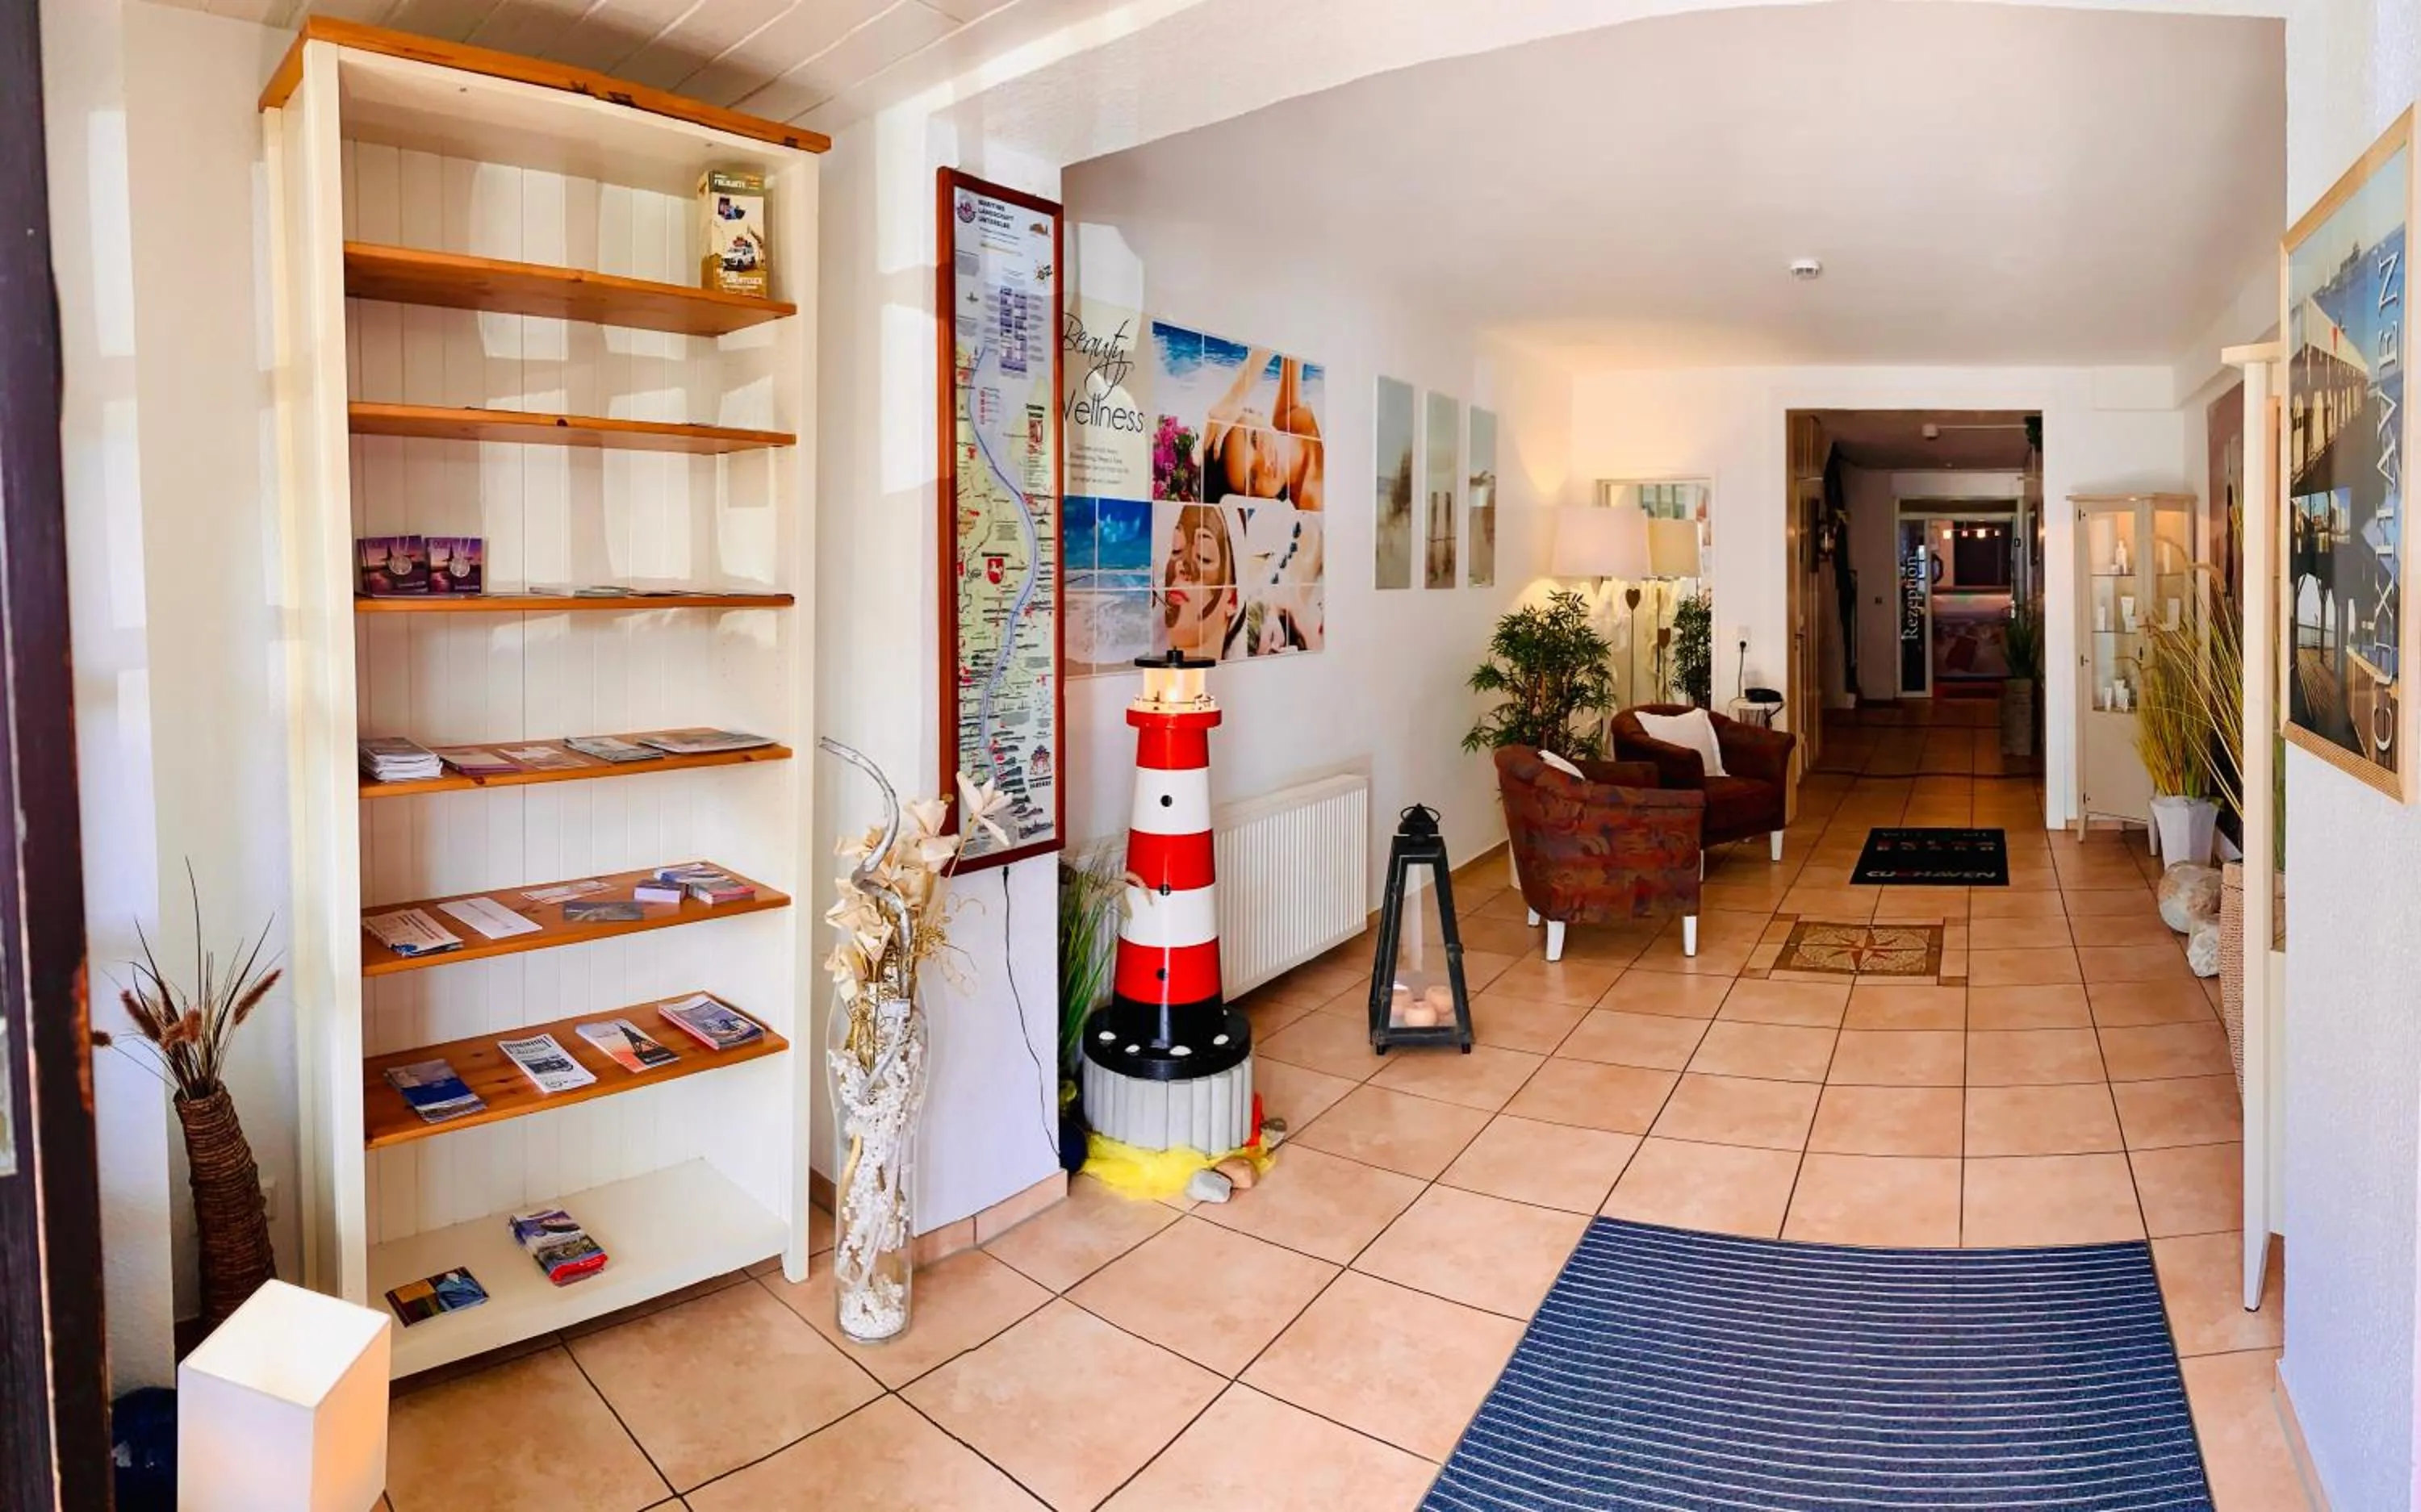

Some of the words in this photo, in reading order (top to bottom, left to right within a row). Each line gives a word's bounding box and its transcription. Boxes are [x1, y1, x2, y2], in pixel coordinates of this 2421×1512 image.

[1063, 312, 1135, 401] Beauty
[2373, 250, 2400, 751] CUXHAVEN
[1900, 555, 1924, 640] Rezeption
